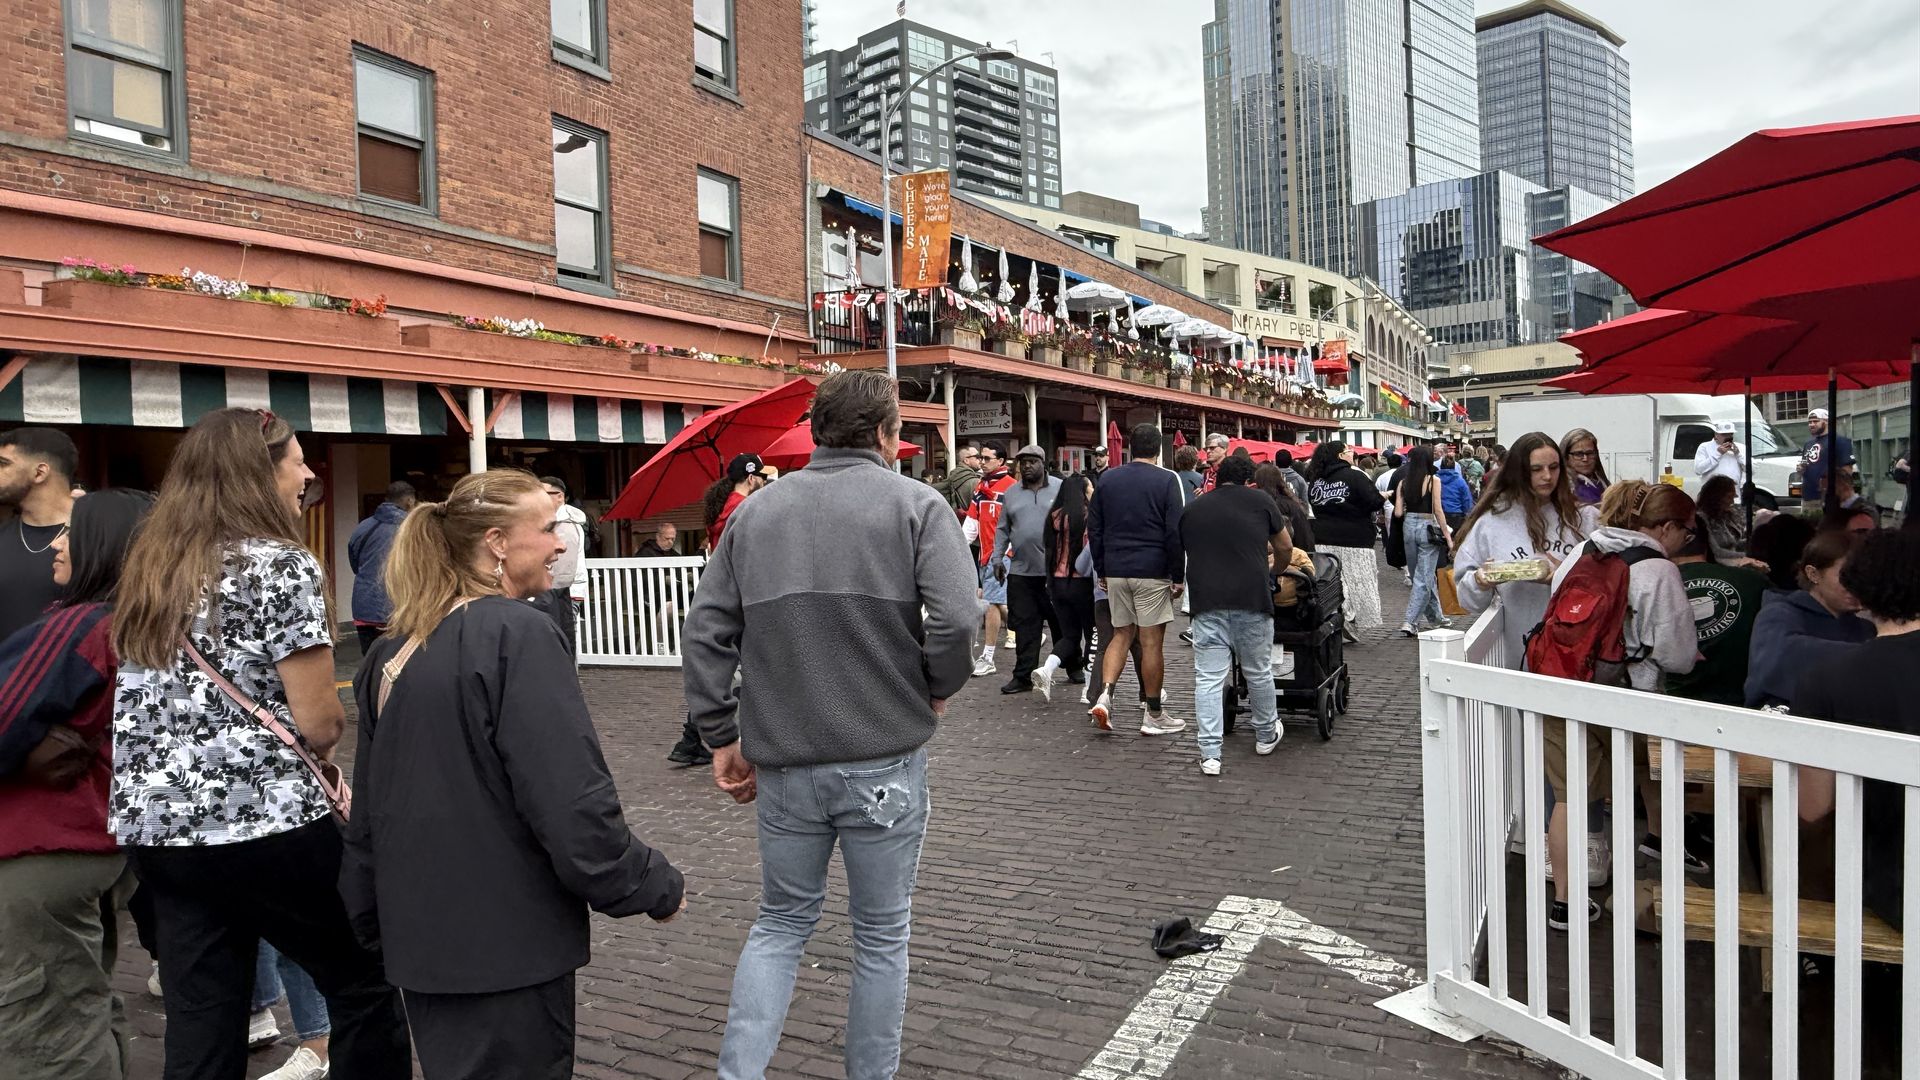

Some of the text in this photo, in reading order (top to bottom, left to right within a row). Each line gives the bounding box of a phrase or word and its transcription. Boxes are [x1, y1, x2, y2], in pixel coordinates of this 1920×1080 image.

[923, 183, 946, 192] We're
[924, 194, 942, 203] glad
[905, 178, 915, 250] CHEERS
[924, 203, 949, 213] you're
[924, 213, 945, 222] here!
[919, 234, 930, 281] MATE
[1289, 321, 1325, 340] PUBLC
[1310, 485, 1350, 502] Dream
